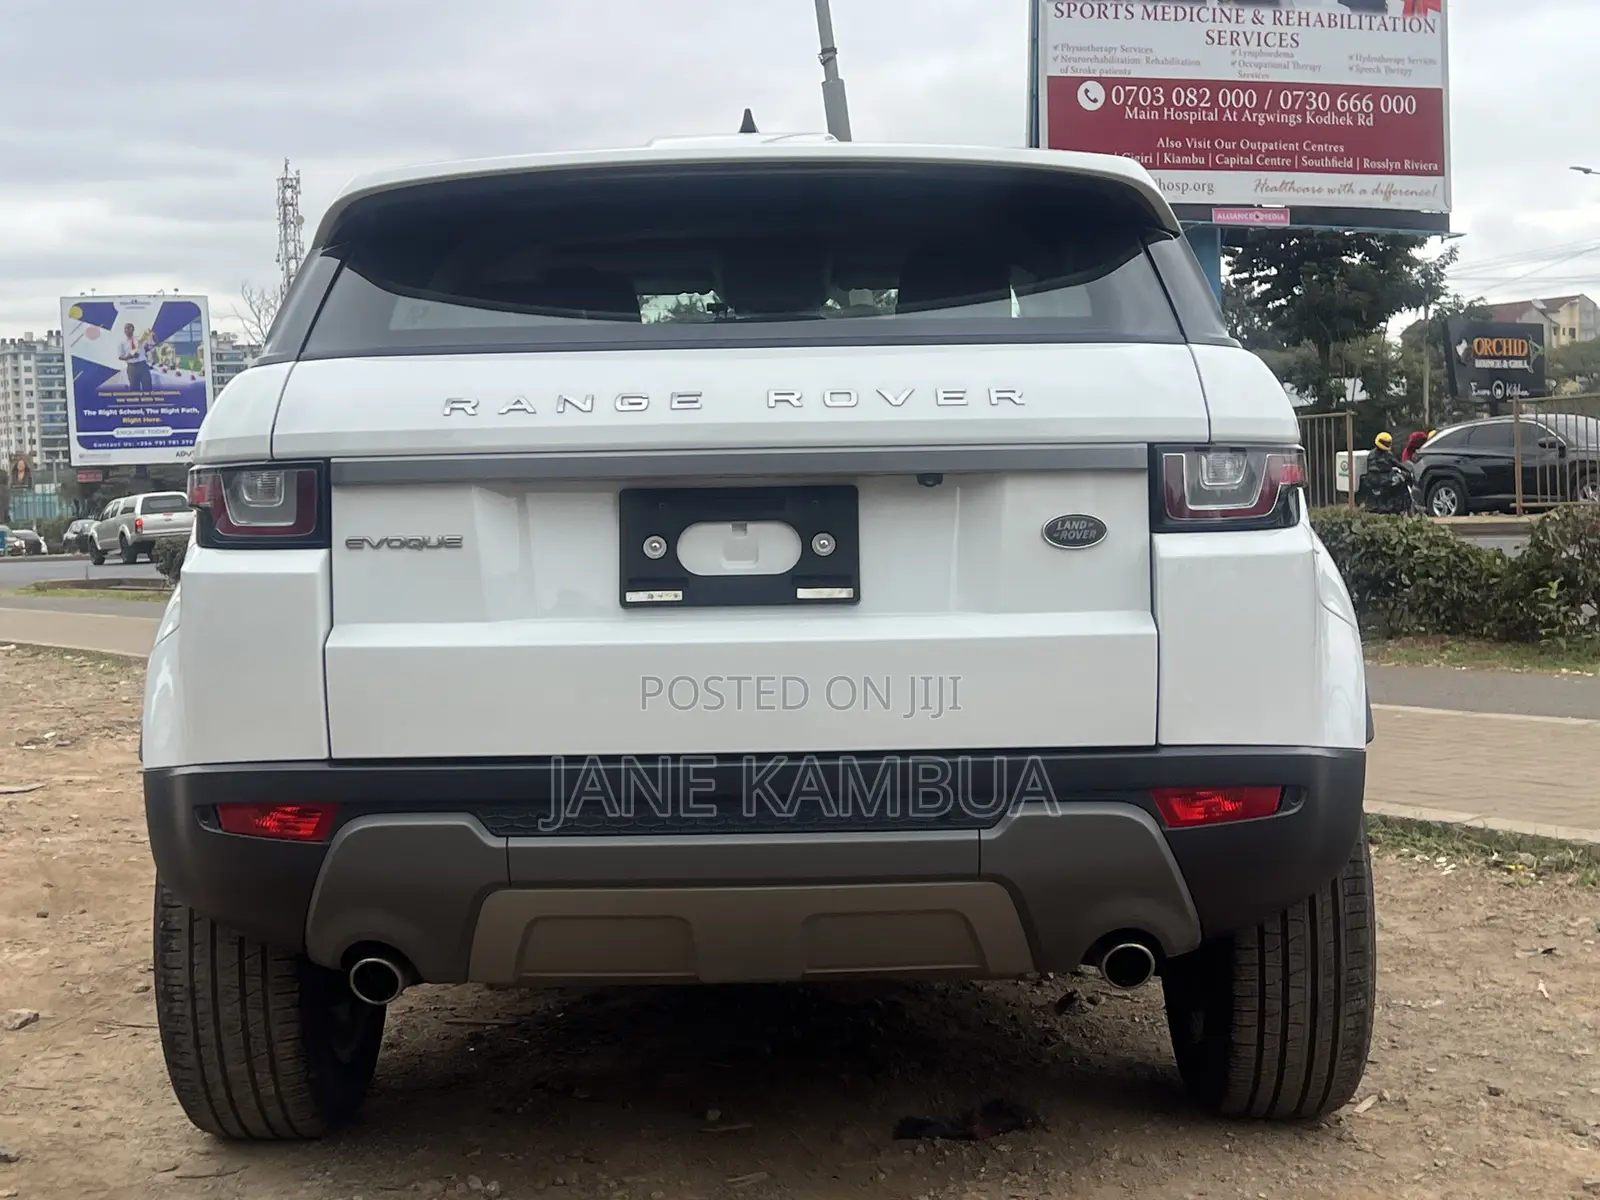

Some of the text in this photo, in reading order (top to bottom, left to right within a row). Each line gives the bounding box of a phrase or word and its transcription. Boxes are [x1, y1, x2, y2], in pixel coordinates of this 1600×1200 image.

[1054, 2, 1436, 34] SPORTS MEDICINE & REHABILITATION
[1205, 29, 1300, 48] SERVICES
[1061, 43, 1153, 54] Physiotherapy Services
[1145, 57, 1201, 66] Rehabilitation
[1238, 60, 1322, 72] Occupational Therapy
[1355, 54, 1437, 66] Hydrotherapy Services
[1060, 66, 1131, 77] of Stroke patients
[1238, 71, 1270, 80] Services
[1355, 64, 1413, 77] Speech Therapy
[1111, 85, 1416, 115] 0703 082 000 / 0730 666 000
[1124, 106, 1374, 126] Main Hospital At Argwings Kodhek Rd
[1156, 137, 1345, 153] Also Visit Our Outpatient Centres
[1163, 153, 1205, 165] Kiambu
[1215, 154, 1253, 167] Capital
[1256, 154, 1292, 167] Centre
[1301, 156, 1353, 169] Southfield
[1363, 158, 1401, 171] Rosslyn
[1404, 159, 1438, 171] Riviera
[1254, 178, 1438, 201] Healthcare with a difference!
[1473, 337, 1528, 357] ORCHID
[443, 386, 1025, 417] RANGE ROVER
[98, 409, 117, 417] Right
[119, 408, 145, 416] School,
[160, 407, 179, 415] Right
[1056, 520, 1086, 530] LAND
[1060, 529, 1097, 540] ROVER
[345, 534, 463, 552] EVOQUE
